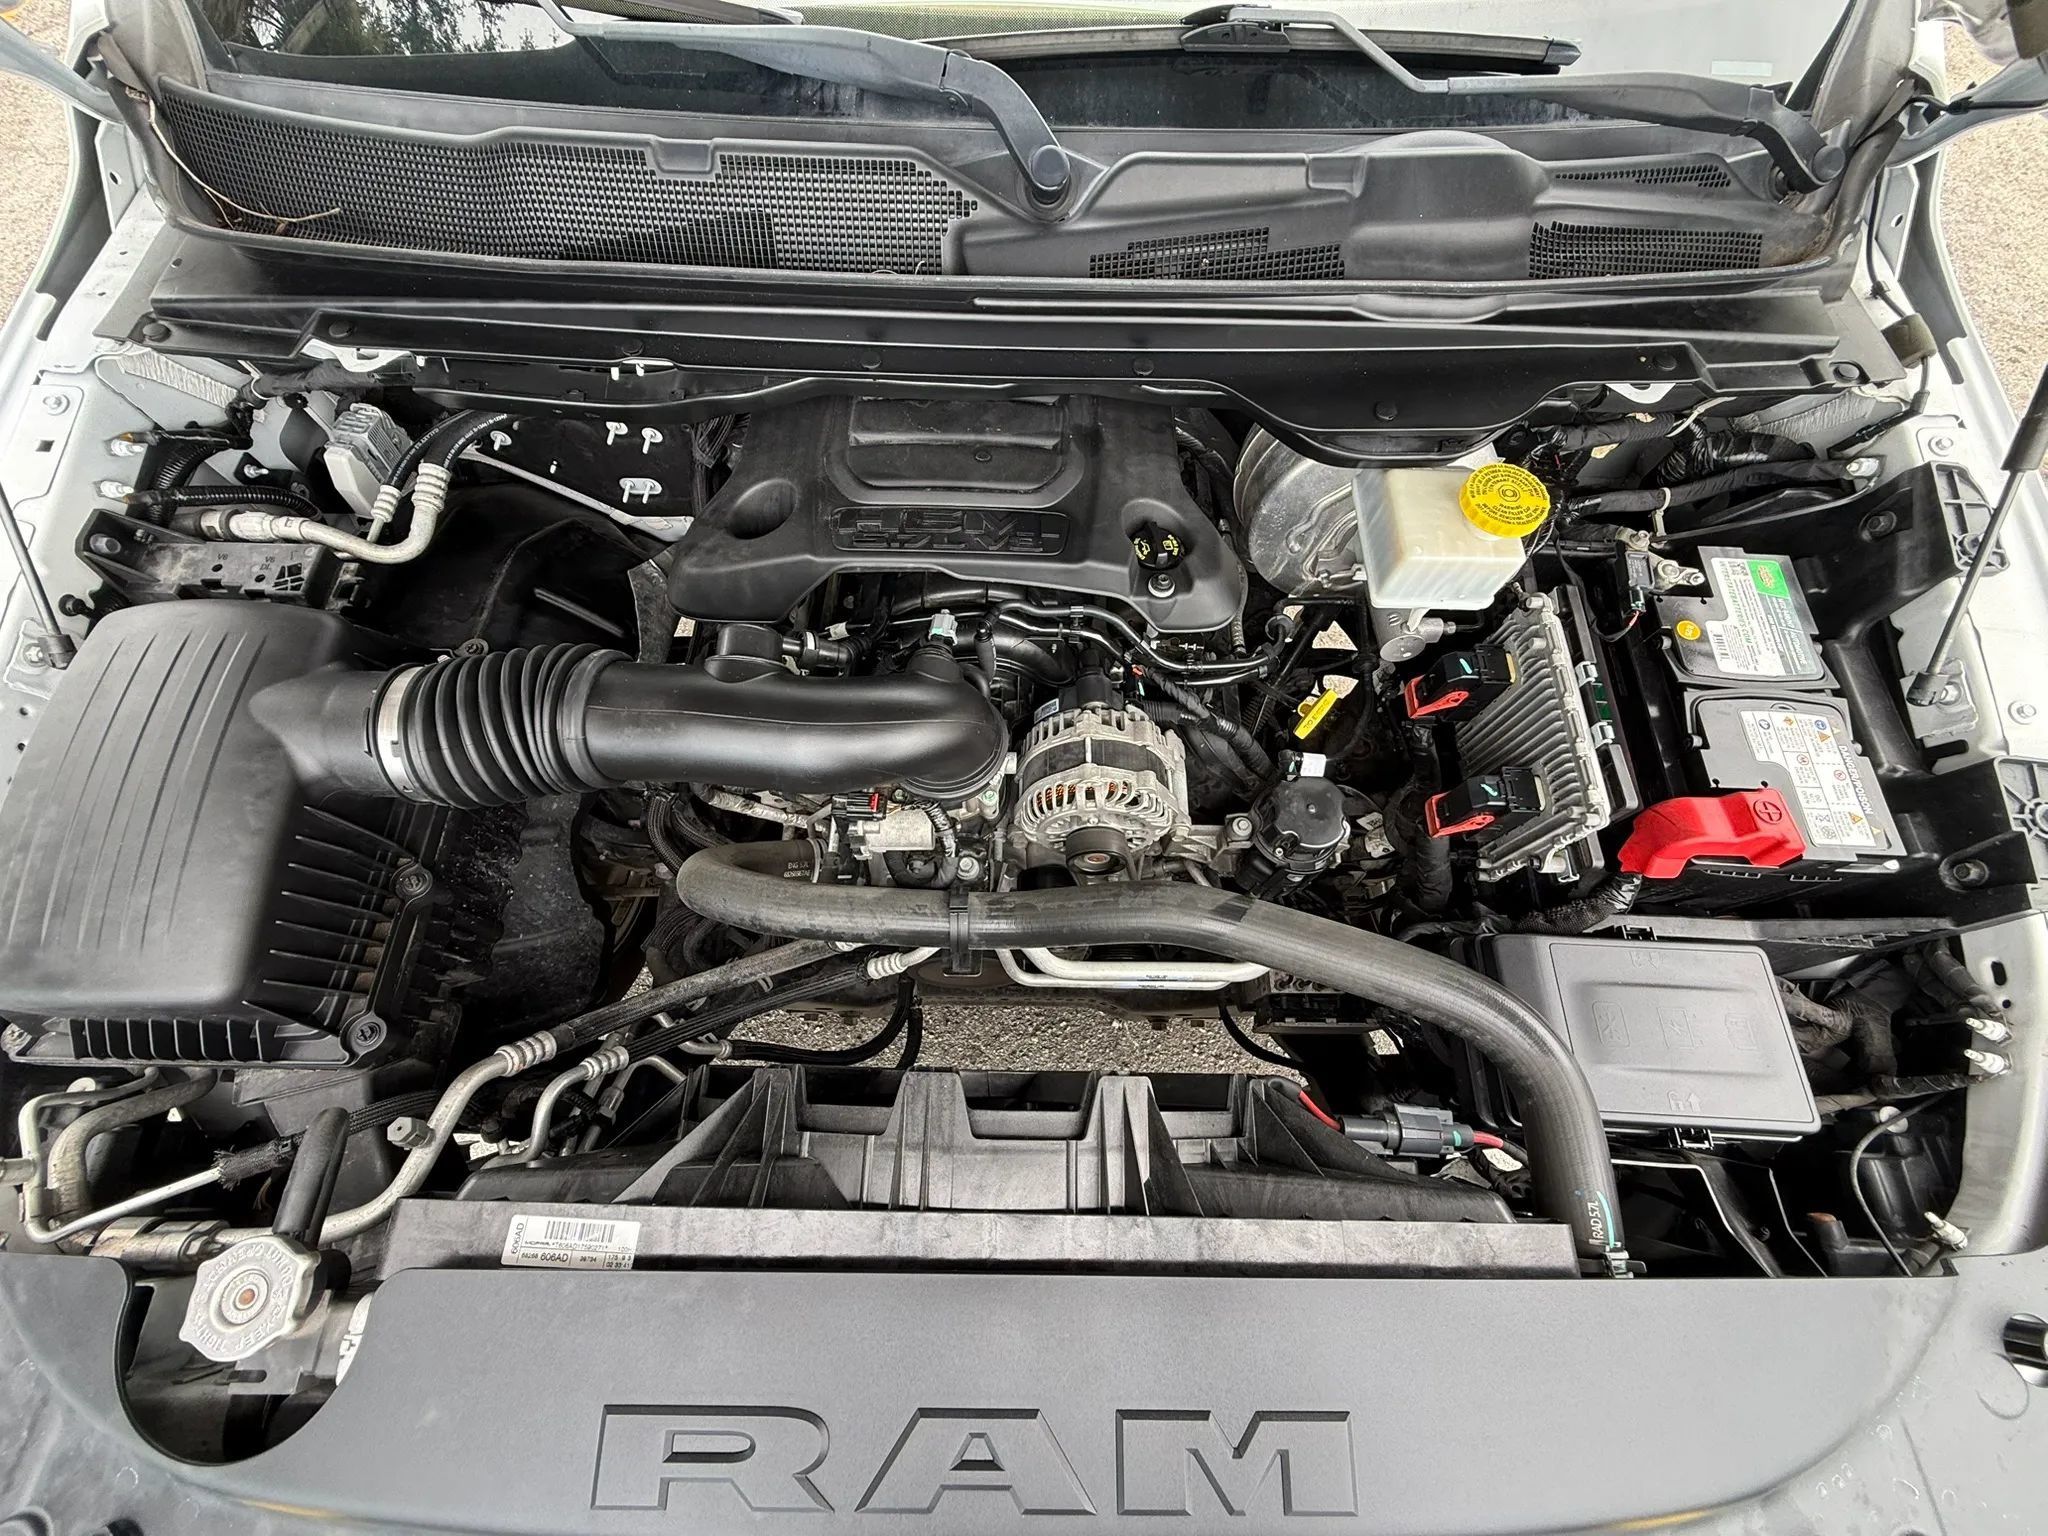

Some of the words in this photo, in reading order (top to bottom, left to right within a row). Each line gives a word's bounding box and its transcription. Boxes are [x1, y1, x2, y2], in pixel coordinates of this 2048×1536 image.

[1838, 745, 1874, 815] DANGER/POISON
[511, 1222, 525, 1254] 606AD
[1591, 1219, 1604, 1239] RAD
[540, 1252, 569, 1263] 606AD
[590, 1404, 1359, 1517] RAM
